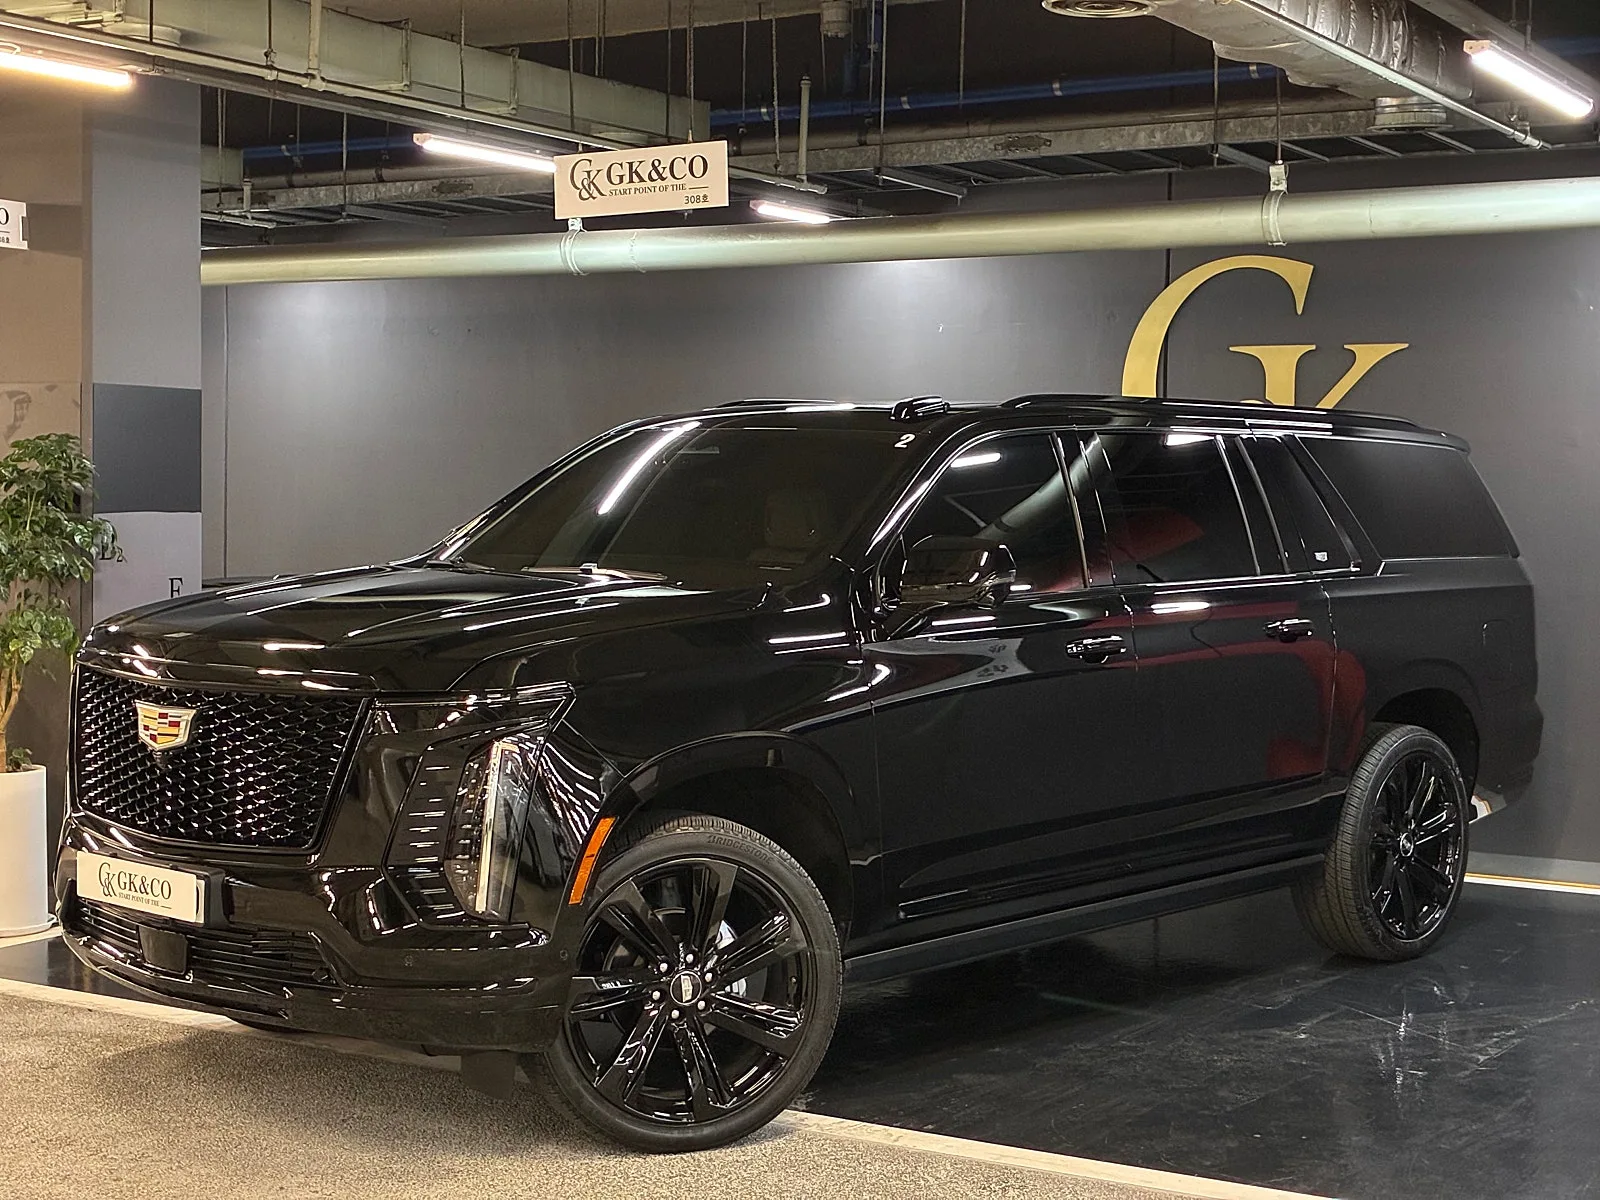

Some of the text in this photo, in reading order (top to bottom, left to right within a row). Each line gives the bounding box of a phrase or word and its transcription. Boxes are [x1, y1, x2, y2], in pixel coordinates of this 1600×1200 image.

[605, 154, 709, 186] GK&CO
[608, 183, 687, 197] START POINT OF THE
[684, 194, 709, 204] 308호
[707, 834, 774, 864] BRIDGESTONE
[117, 870, 172, 900] GK&CO
